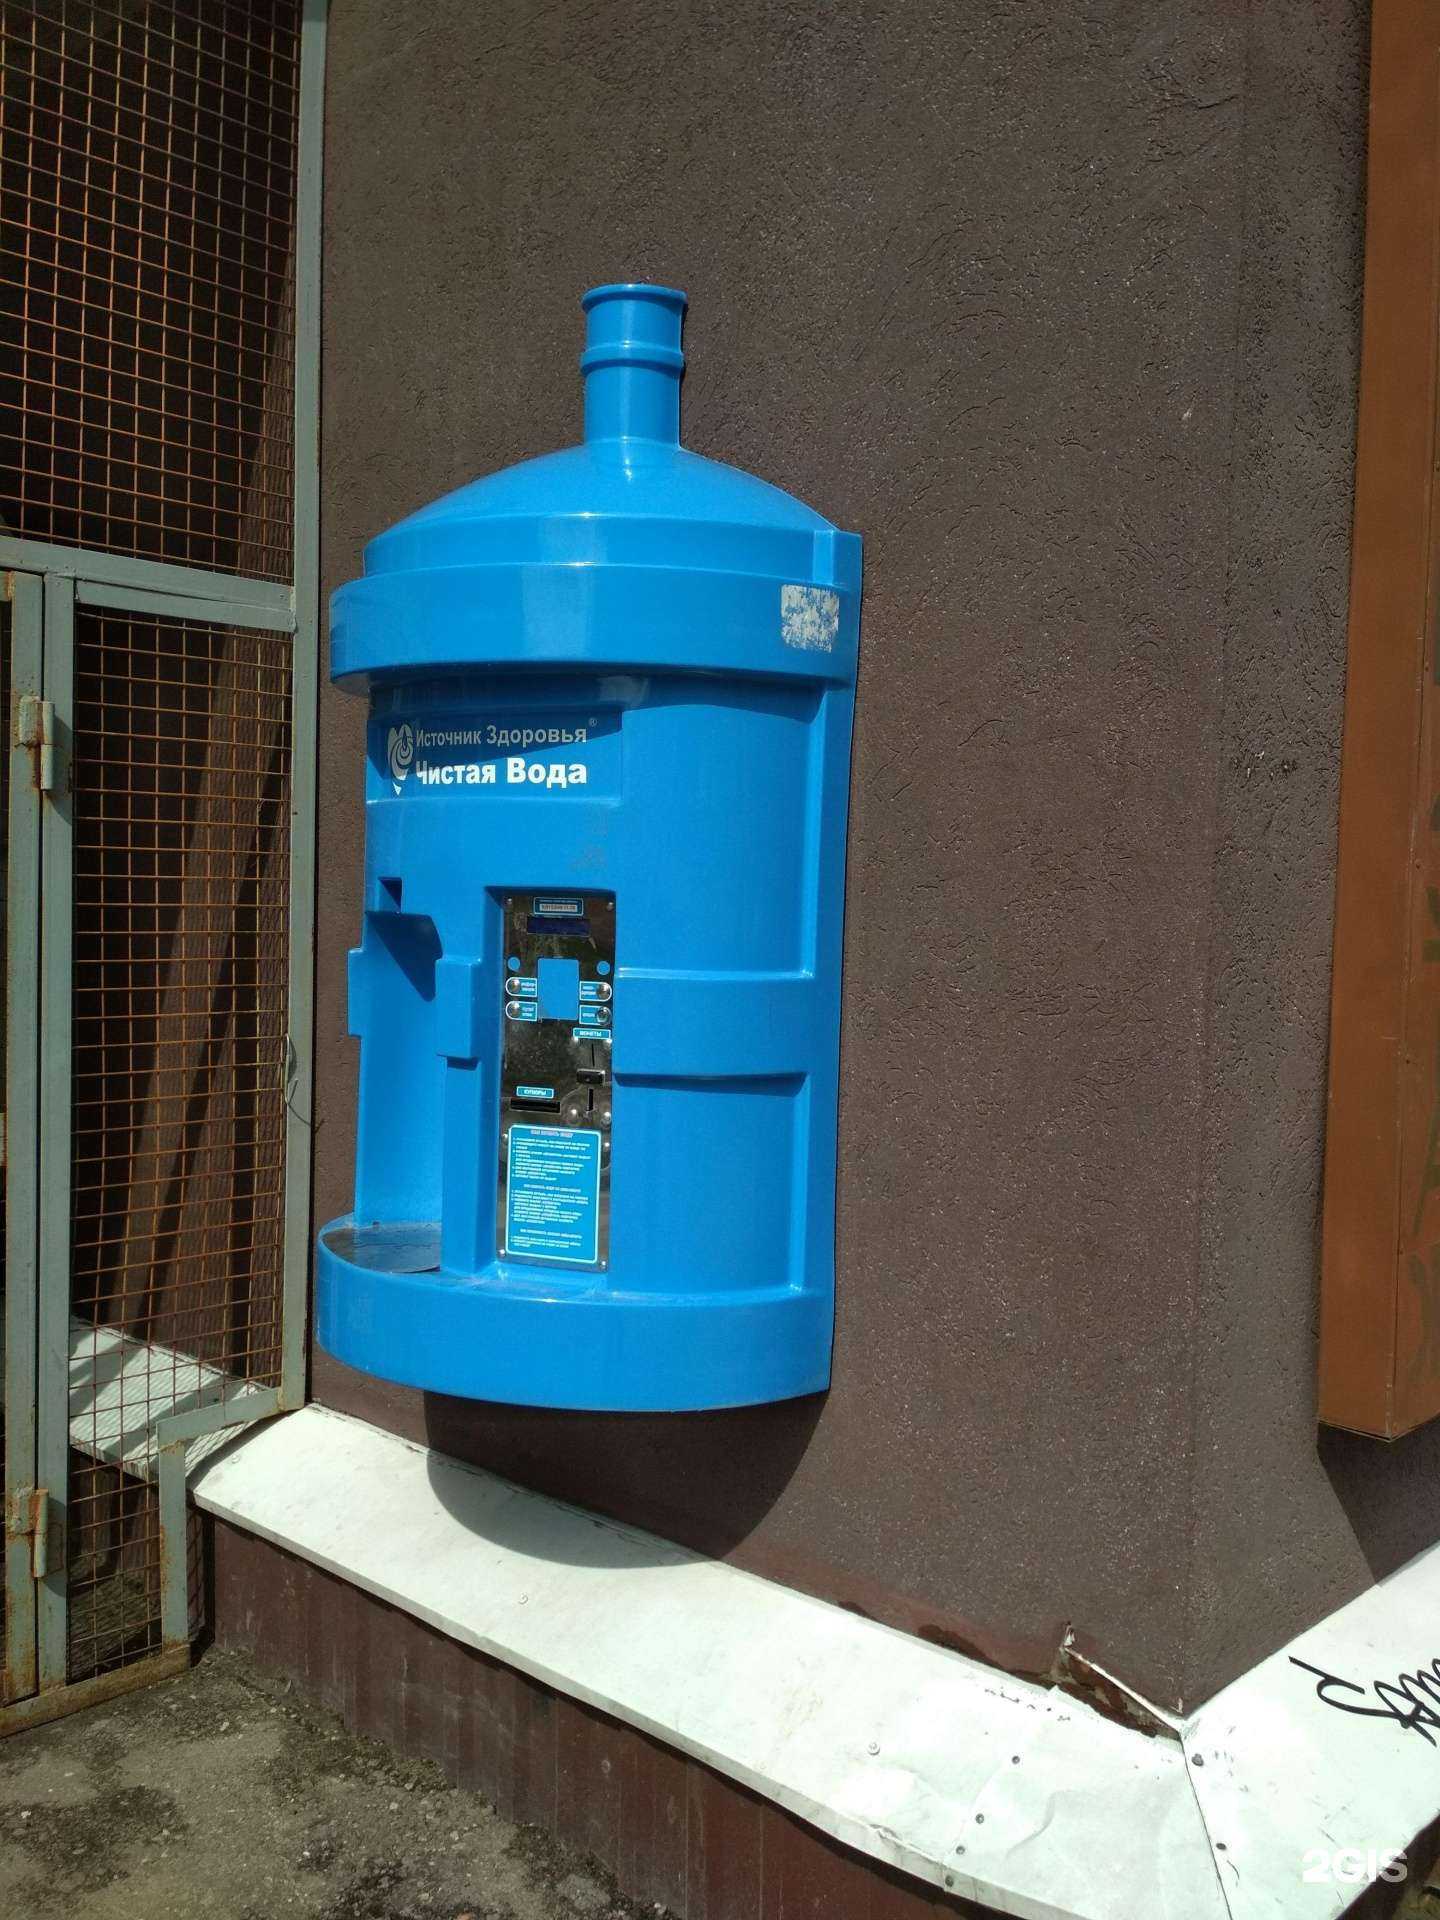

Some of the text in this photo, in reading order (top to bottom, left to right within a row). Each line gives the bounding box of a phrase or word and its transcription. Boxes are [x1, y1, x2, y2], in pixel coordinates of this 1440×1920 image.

[416, 725, 587, 748] Источник Здоровья
[415, 757, 588, 789] Чистая Вода
